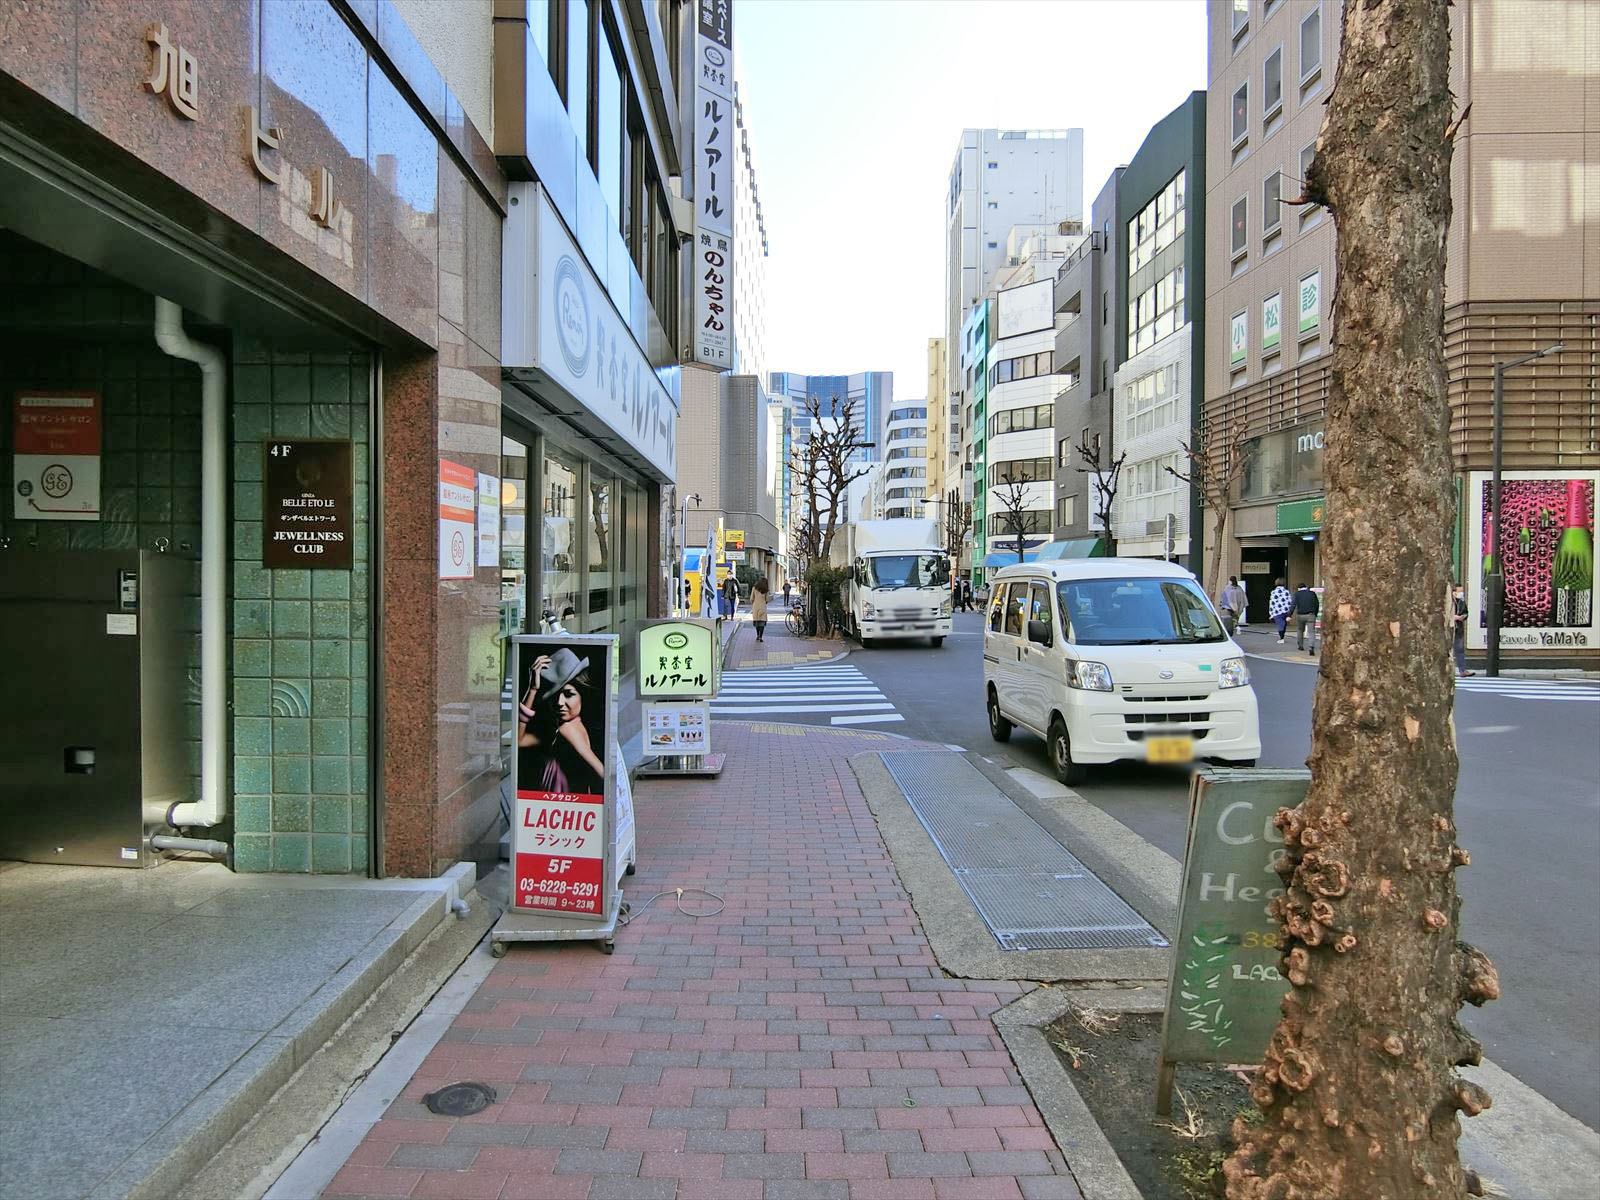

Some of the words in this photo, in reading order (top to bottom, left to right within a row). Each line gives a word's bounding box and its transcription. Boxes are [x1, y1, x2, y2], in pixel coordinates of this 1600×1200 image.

[144, 20, 345, 230] 旭ビル
[704, 99, 724, 219] ルノアール
[704, 251, 724, 331] のんちゃん
[282, 499, 306, 507] BELLE
[273, 531, 344, 541] JEWELLNESS
[293, 544, 324, 554] CLUB
[1539, 632, 1587, 646] YaMaYa
[645, 673, 707, 688] ルノアール
[543, 793, 580, 802] ヘアサロン
[523, 807, 596, 832] LACHIC
[535, 833, 586, 849] ラシック
[547, 858, 572, 873] 5F
[520, 877, 599, 897] 03-6228-5291
[524, 895, 557, 906] 営業時間
